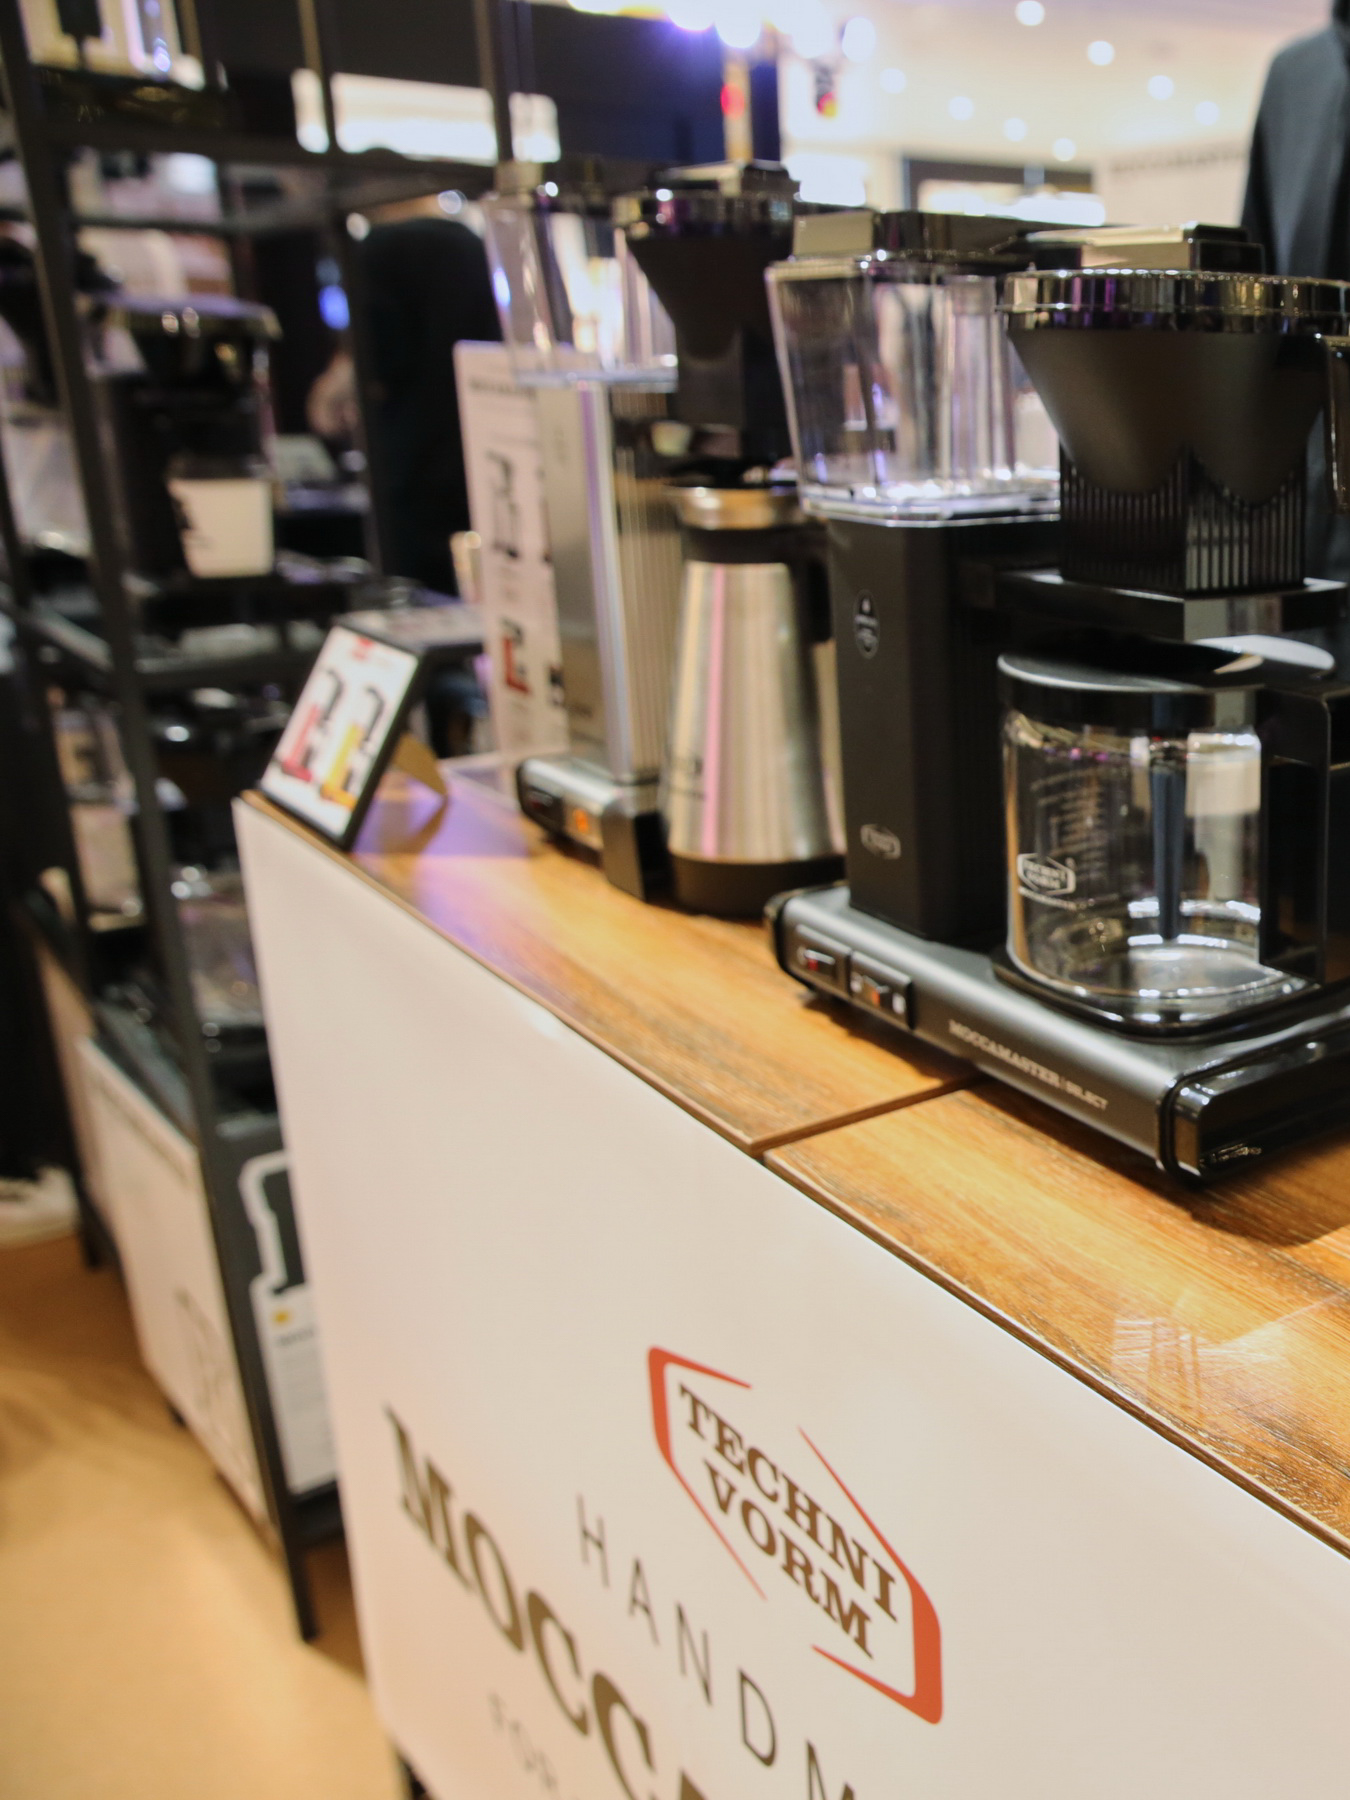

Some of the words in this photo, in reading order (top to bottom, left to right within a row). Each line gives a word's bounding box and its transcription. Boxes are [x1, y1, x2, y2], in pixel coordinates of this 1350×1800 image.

[949, 1018, 1061, 1089] MOCCAMASTER
[680, 1382, 898, 1623] TECHNI
[703, 1458, 875, 1661] VORM
